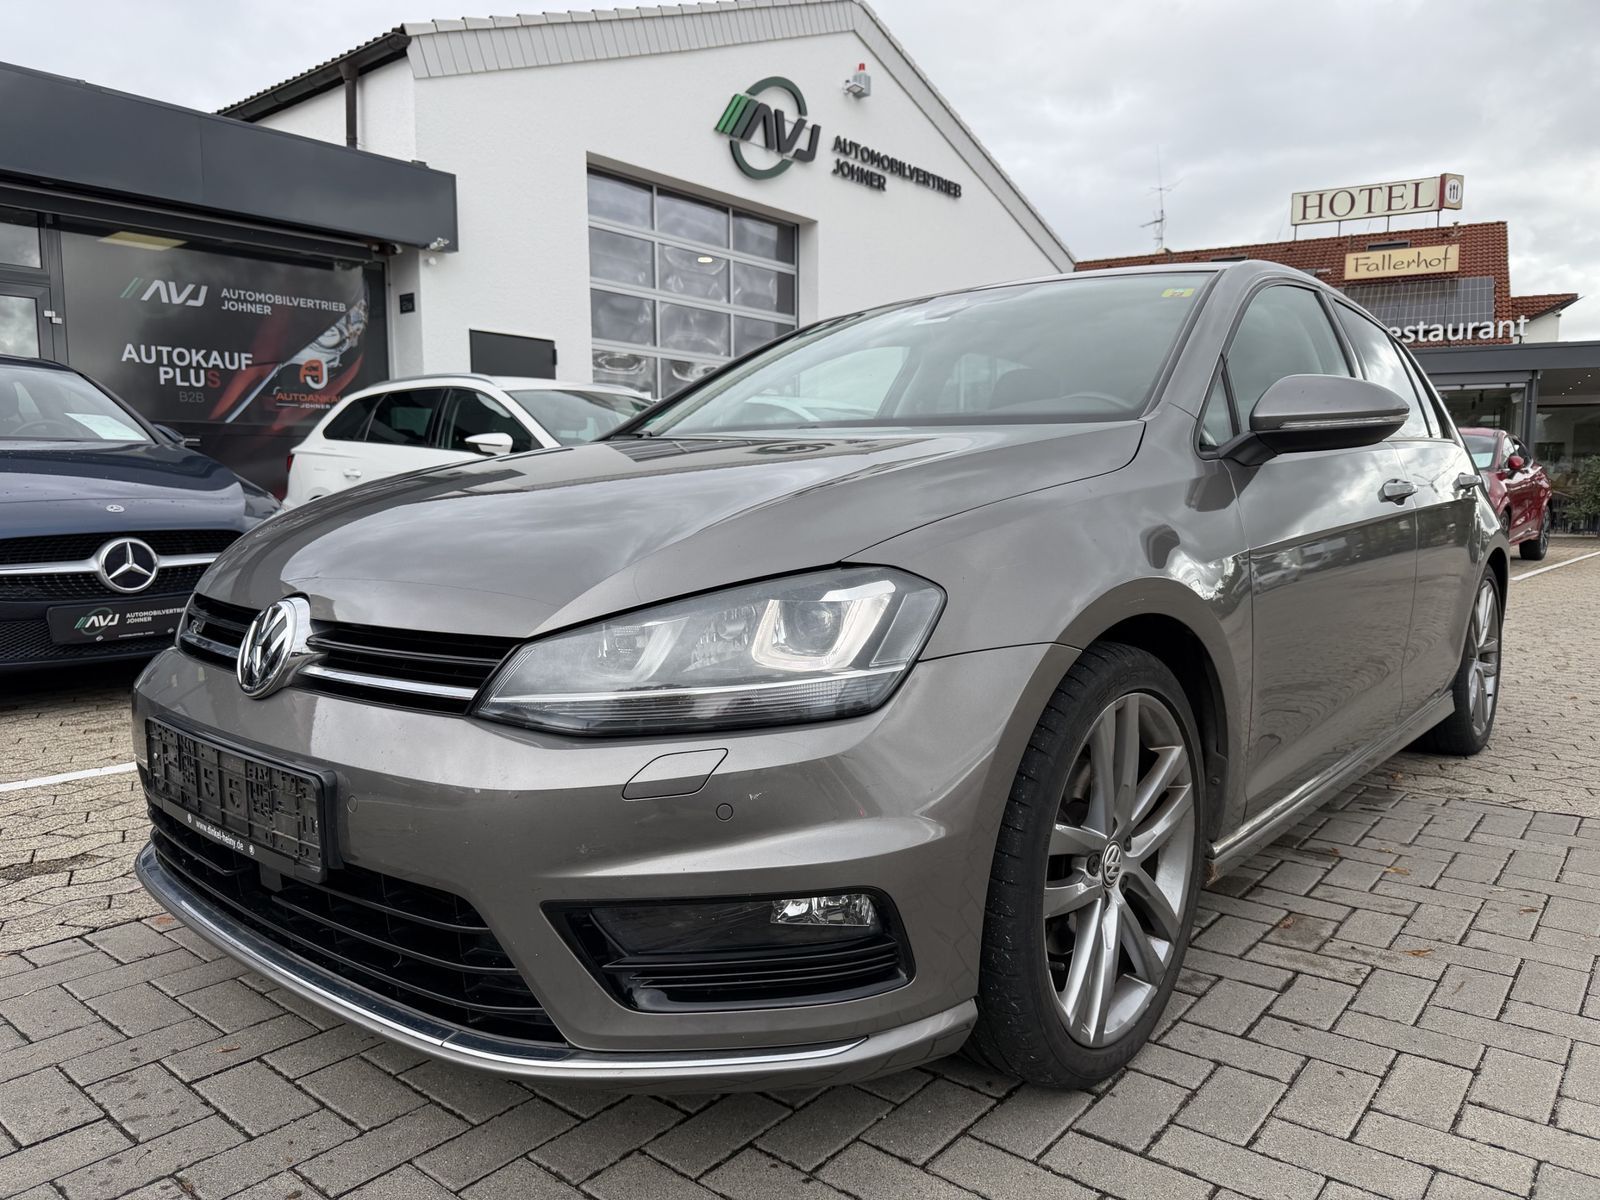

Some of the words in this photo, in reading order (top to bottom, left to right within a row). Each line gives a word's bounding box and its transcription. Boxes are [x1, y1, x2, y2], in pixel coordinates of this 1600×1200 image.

[832, 135, 962, 198] AUTOMOBILVERTRIEB
[832, 158, 886, 191] JOHNER
[1300, 181, 1435, 221] HOTEL
[1353, 245, 1452, 273] Fallerhof
[140, 279, 208, 307] AVJ
[221, 287, 347, 312] AUTOMOBILVERTRIEB
[221, 303, 272, 315] JOHNER
[1387, 314, 1530, 344] estaurant
[121, 343, 253, 370] AUTOKAUF
[159, 367, 221, 388] PLUS
[179, 391, 205, 403] B2B
[276, 392, 341, 403] AUTOANKA
[85, 613, 120, 628] AVJ
[126, 607, 187, 618] AUTOMOBILVERTRI
[126, 616, 153, 625] JOHNER
